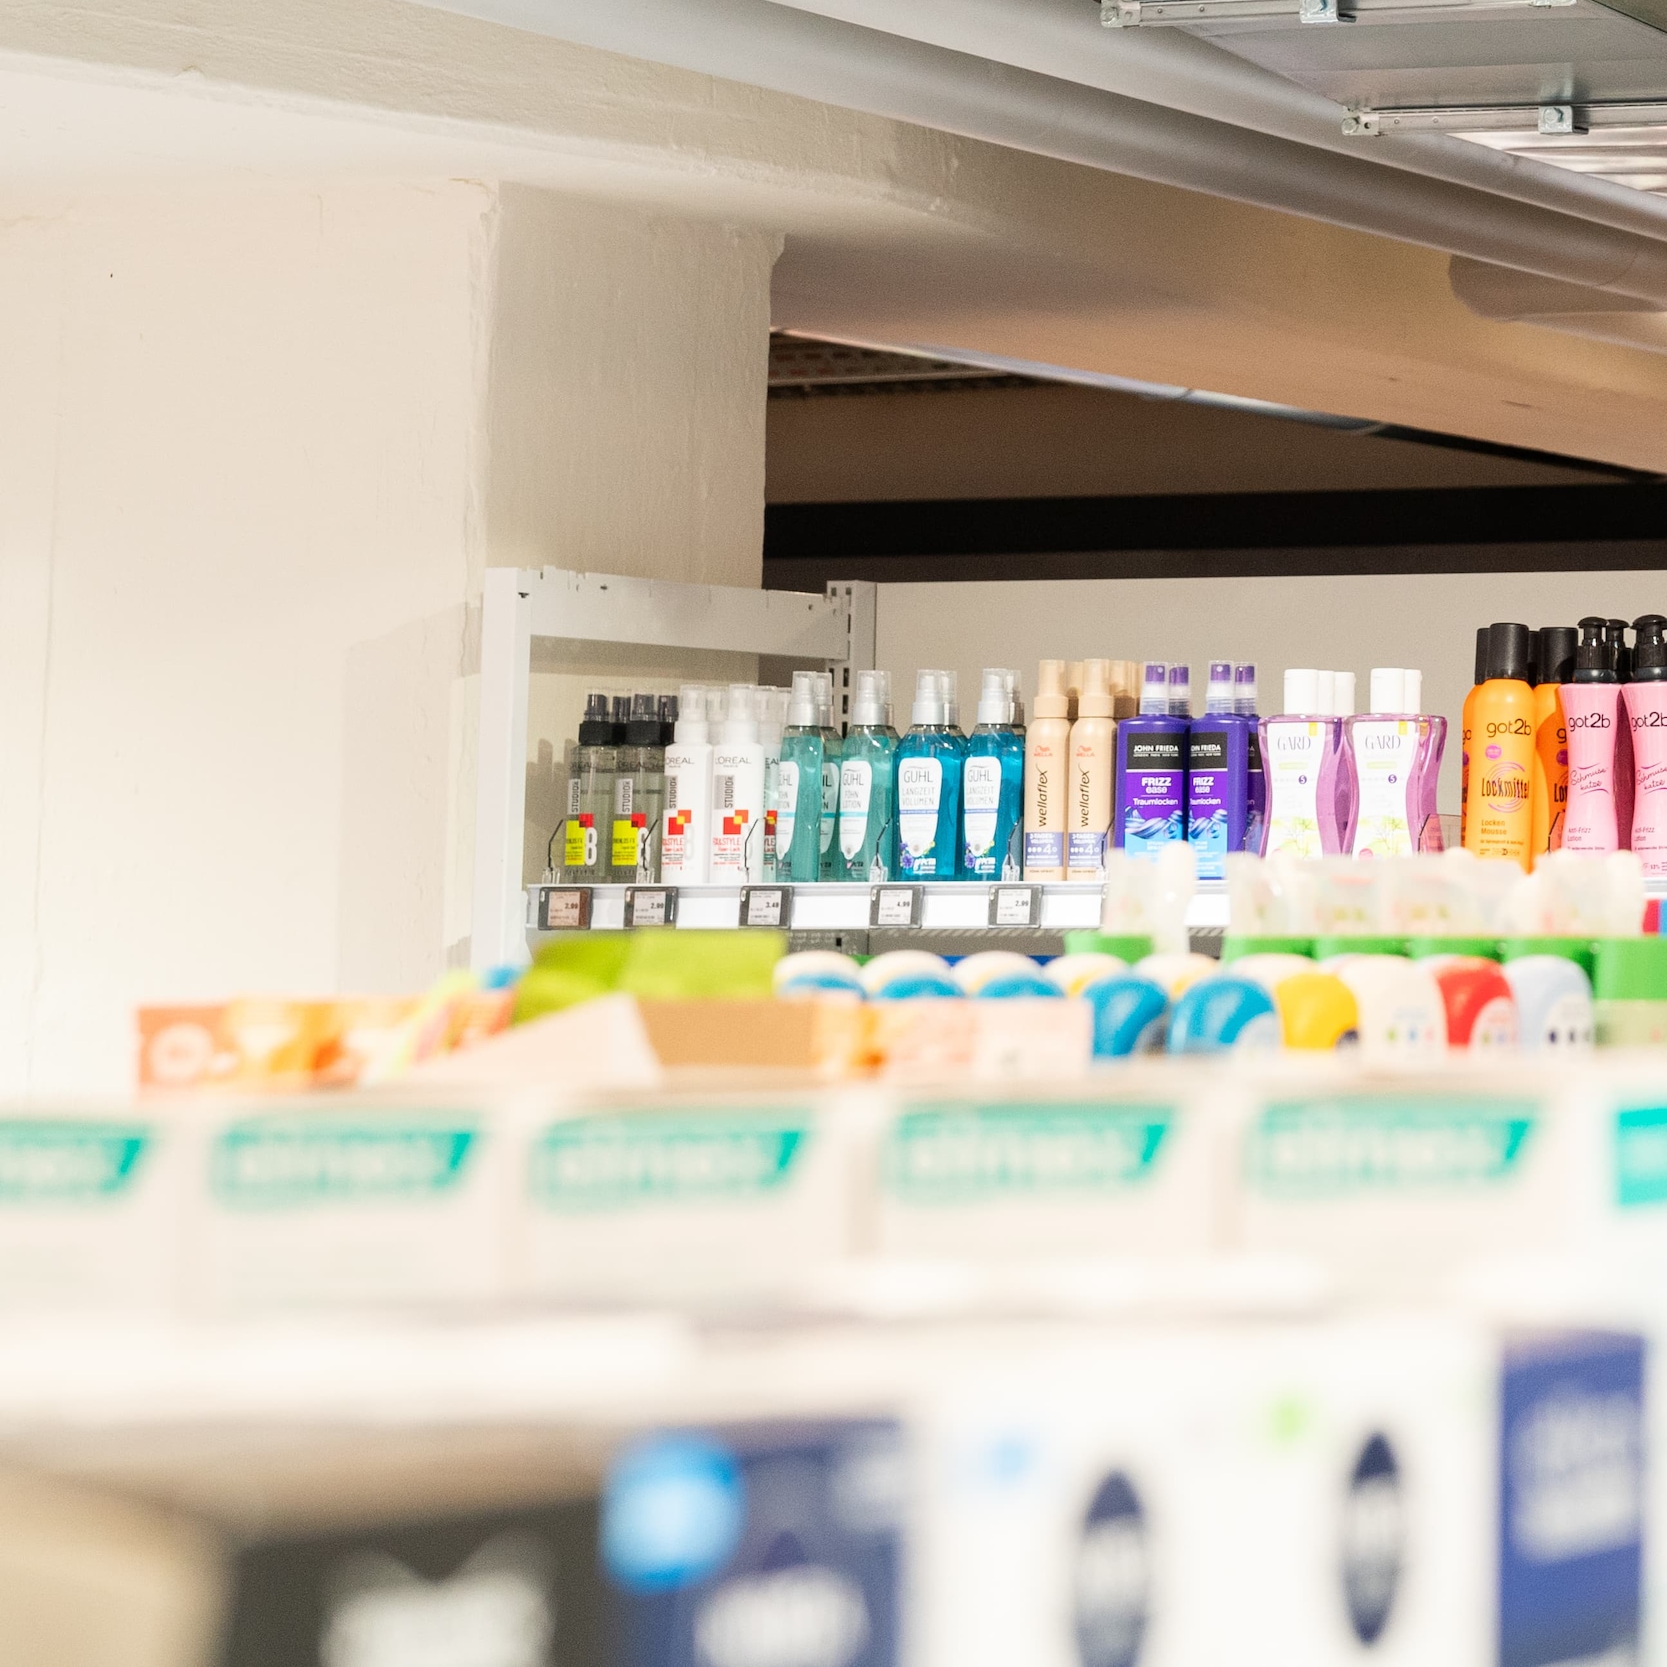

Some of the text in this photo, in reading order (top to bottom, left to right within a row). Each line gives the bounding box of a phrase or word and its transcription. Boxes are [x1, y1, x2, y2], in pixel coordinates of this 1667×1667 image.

[1487, 719, 1531, 738] got2b
[1569, 713, 1610, 732] got2b
[1278, 734, 1311, 751] GARD
[1365, 734, 1400, 750] GARD
[904, 771, 933, 783] GUHL
[968, 770, 992, 782] GUHL
[1142, 778, 1171, 786] FRIZZ
[902, 787, 935, 795] LANGZEIT
[1036, 764, 1048, 827] wellaflex
[1078, 764, 1090, 827] wellaflex
[902, 796, 934, 805] VOLUMEN
